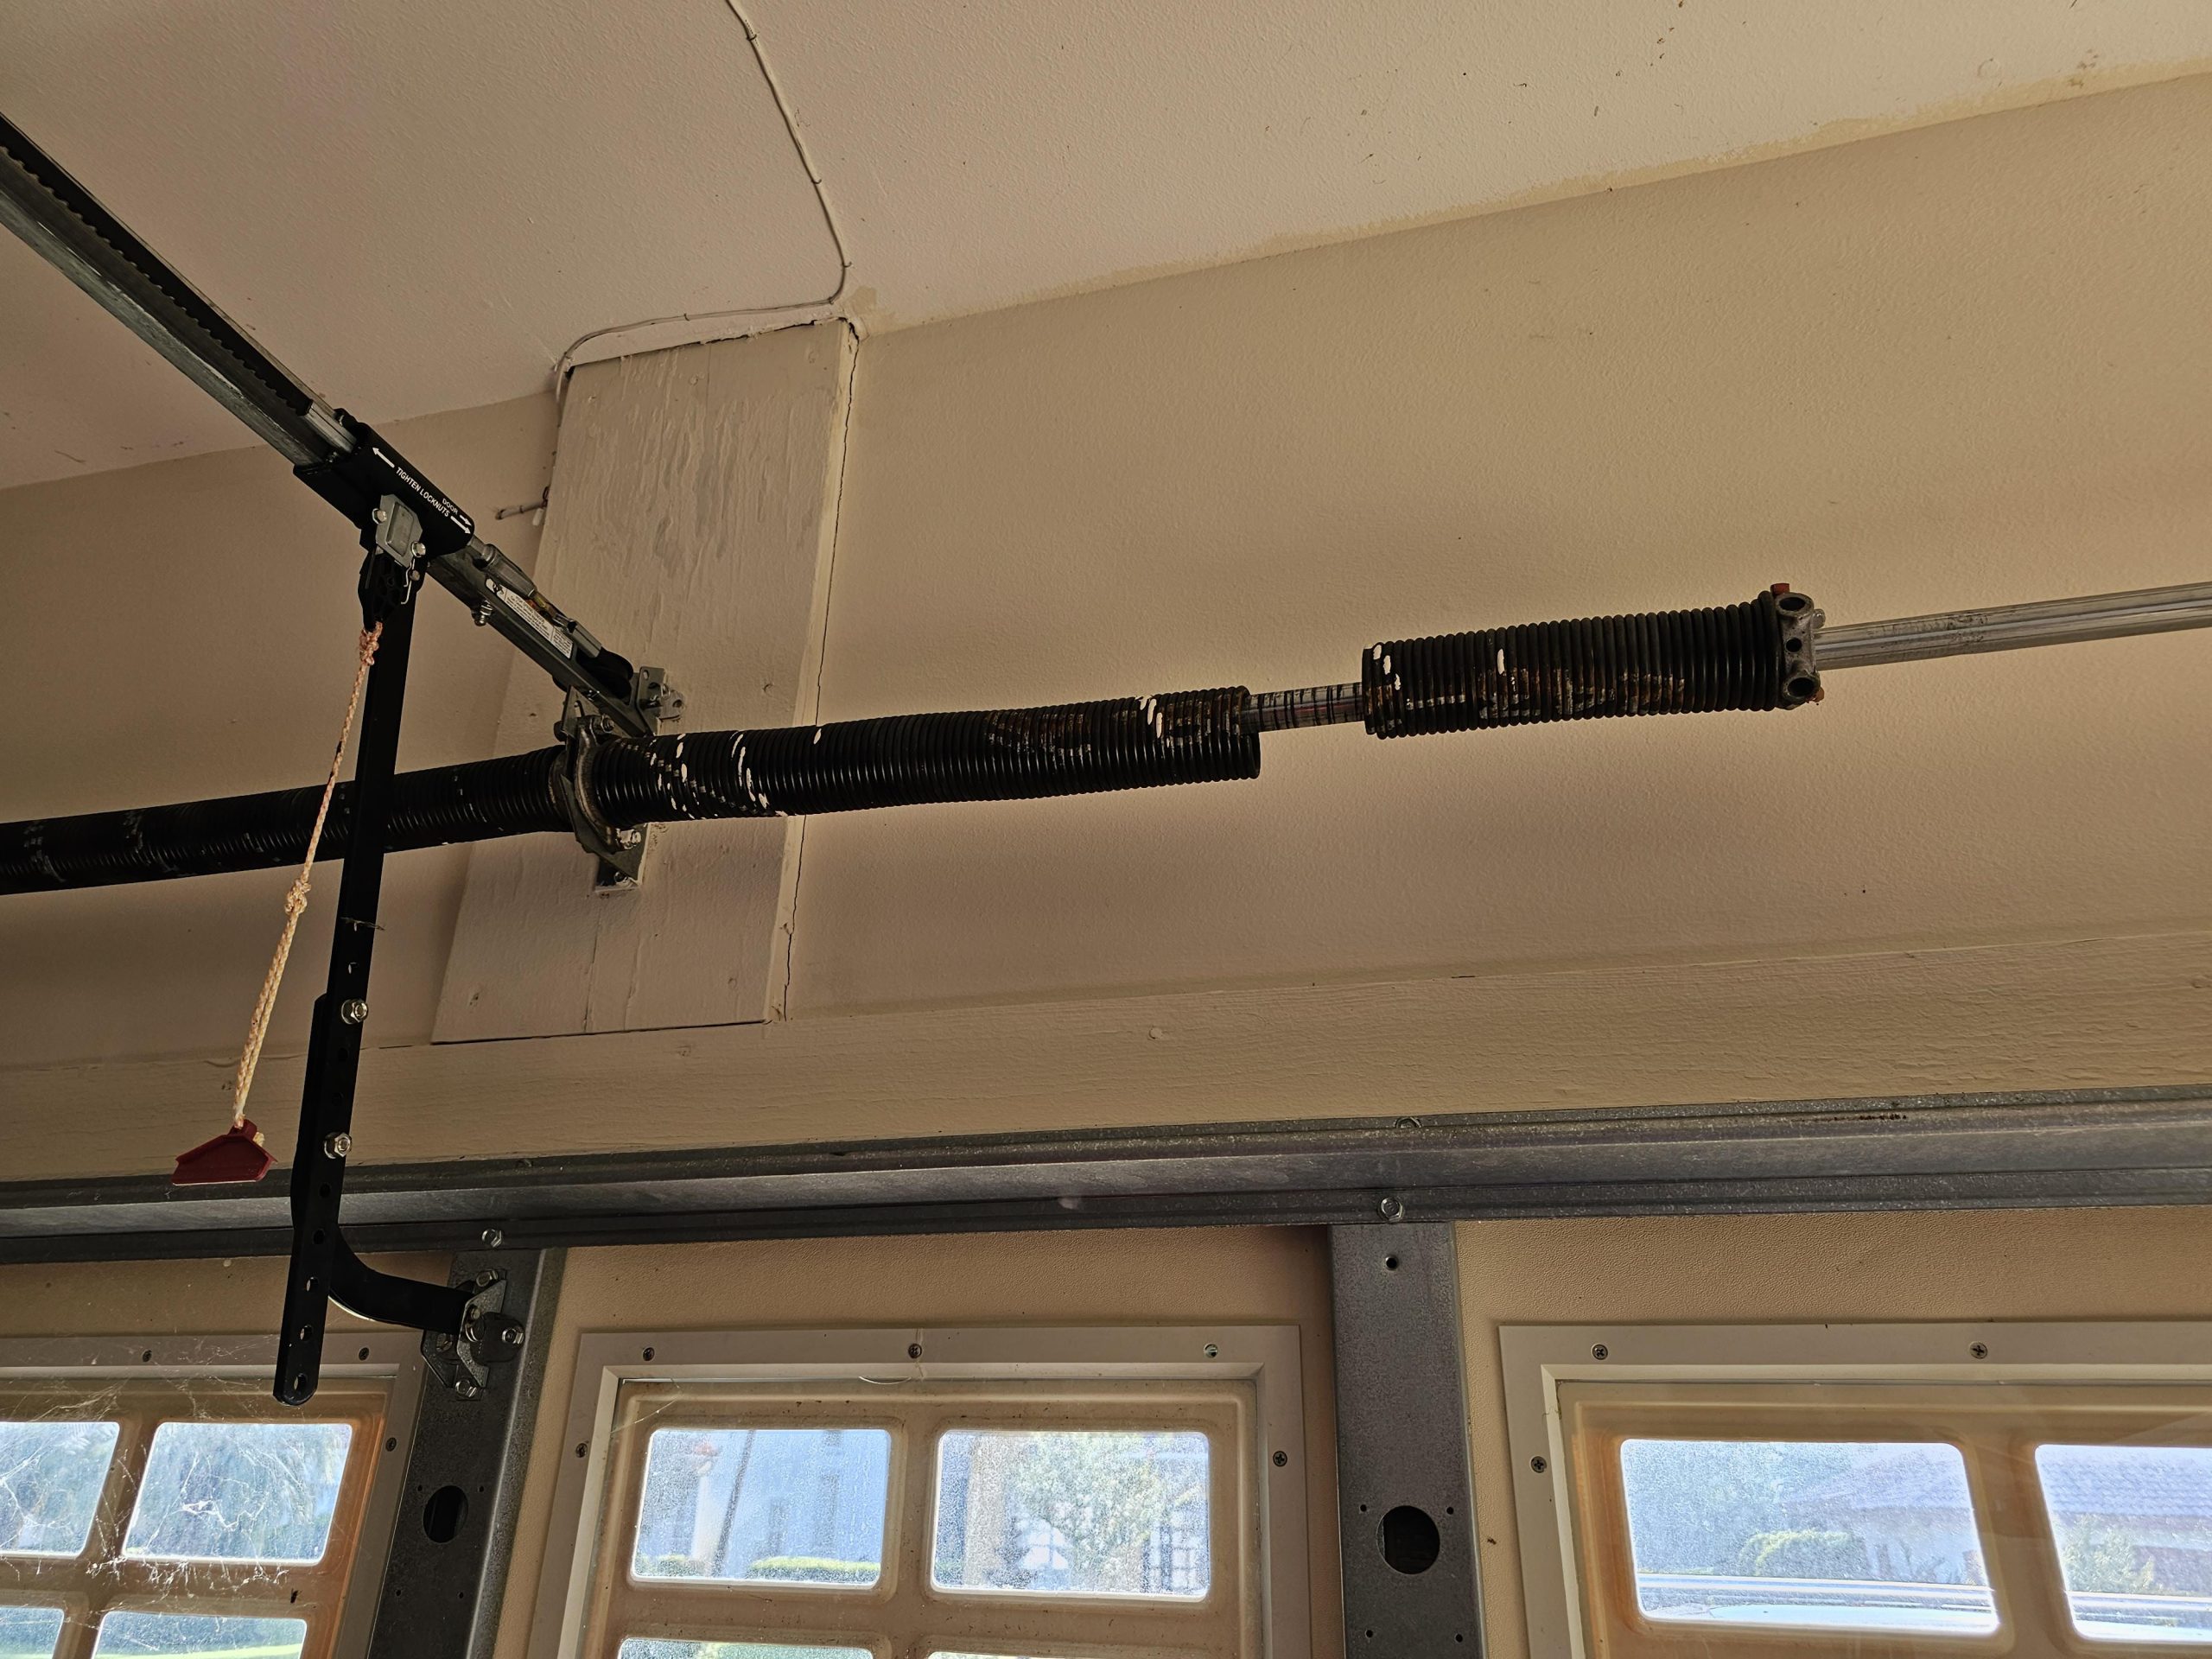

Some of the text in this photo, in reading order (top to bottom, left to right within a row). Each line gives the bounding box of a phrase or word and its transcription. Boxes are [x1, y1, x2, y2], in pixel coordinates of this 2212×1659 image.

[396, 467, 450, 517] TIGHTEN LOCKNUTS
[442, 498, 459, 514] DOOR
